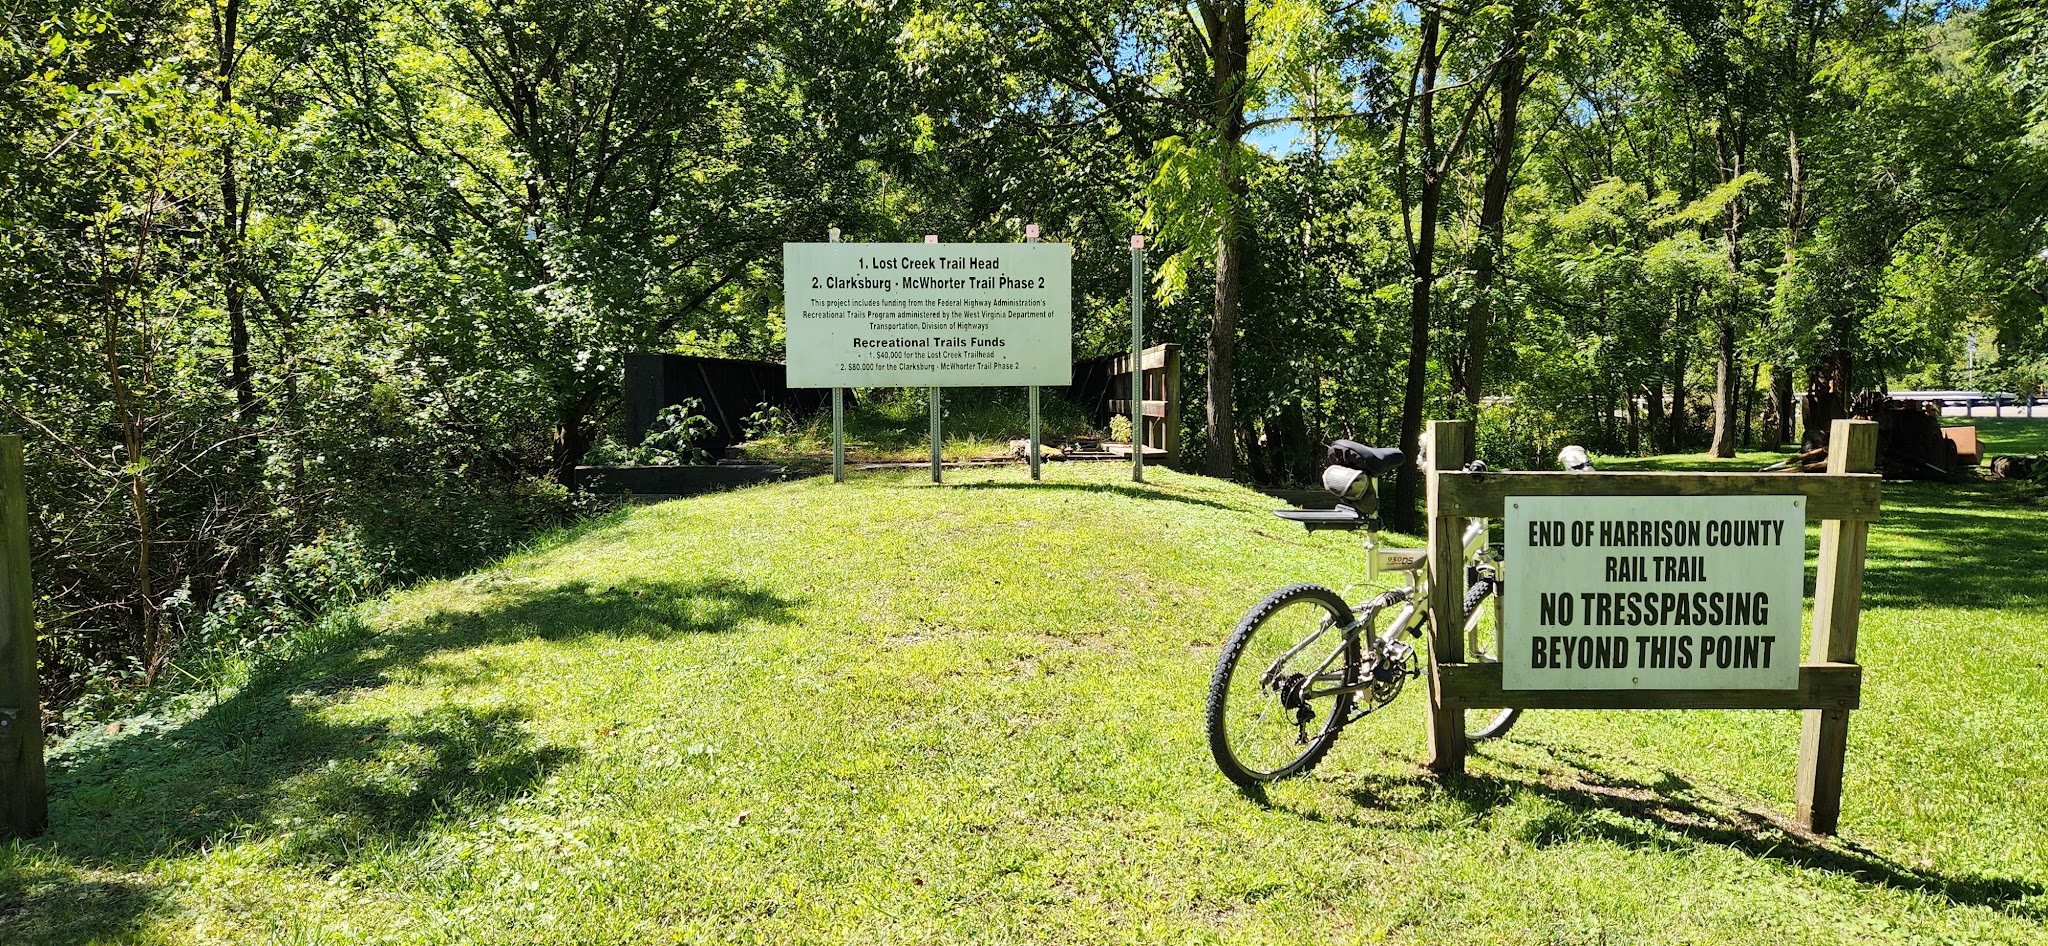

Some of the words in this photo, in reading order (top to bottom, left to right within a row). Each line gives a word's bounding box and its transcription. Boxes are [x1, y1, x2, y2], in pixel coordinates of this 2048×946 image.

[859, 257, 869, 269] 1.
[872, 257, 898, 269] Lost
[901, 257, 936, 269] Creek
[939, 257, 966, 269] Trail
[969, 257, 999, 269] Head
[812, 277, 822, 289] 2.
[826, 277, 891, 292] Clarksburg
[902, 277, 966, 289] McWhorter
[969, 277, 995, 289] Trail
[999, 277, 1034, 289] Phase
[1038, 277, 1045, 289] 2
[811, 299, 825, 307] This
[826, 299, 850, 308] project
[852, 299, 880, 307] includes
[881, 299, 907, 308] funding
[908, 299, 923, 307] from
[924, 299, 936, 307] the
[938, 299, 962, 307] Federal
[963, 299, 992, 308] Highway
[993, 299, 1046, 307] Administration's
[803, 311, 845, 319] Recreational
[847, 311, 866, 319] Trails
[867, 311, 896, 320] Program
[897, 311, 940, 319] administered
[942, 311, 950, 320] by
[951, 311, 962, 319] the
[964, 311, 980, 319] West
[981, 311, 1007, 320] Virginia
[1008, 311, 1046, 320] Department
[1048, 311, 1054, 319] of
[869, 322, 920, 331] Transportation,
[921, 322, 947, 330] Division
[949, 322, 956, 330] of
[957, 322, 989, 331] Highways
[853, 337, 930, 348] Recreational
[934, 337, 967, 348] Trails
[971, 337, 1005, 348] Funds
[876, 352, 902, 360] $40,000
[899, 363, 935, 372] Clarksburg
[941, 362, 976, 370] McWhorter
[977, 362, 992, 370] Trail
[993, 362, 1013, 370] Phase
[1015, 362, 1019, 370] 2
[1529, 521, 1565, 547] END
[1571, 521, 1595, 547] OF
[1600, 521, 1700, 547] HARRISON
[1706, 520, 1784, 547] COUNTY
[1605, 556, 1647, 582] RAIL
[1653, 556, 1706, 582] TRAIL
[1541, 592, 1573, 626] NO
[1581, 592, 1768, 626] TRESSPASSING
[1532, 636, 1628, 669] BEYOND
[1636, 636, 1693, 669] THIS
[1700, 636, 1776, 669] POINT
